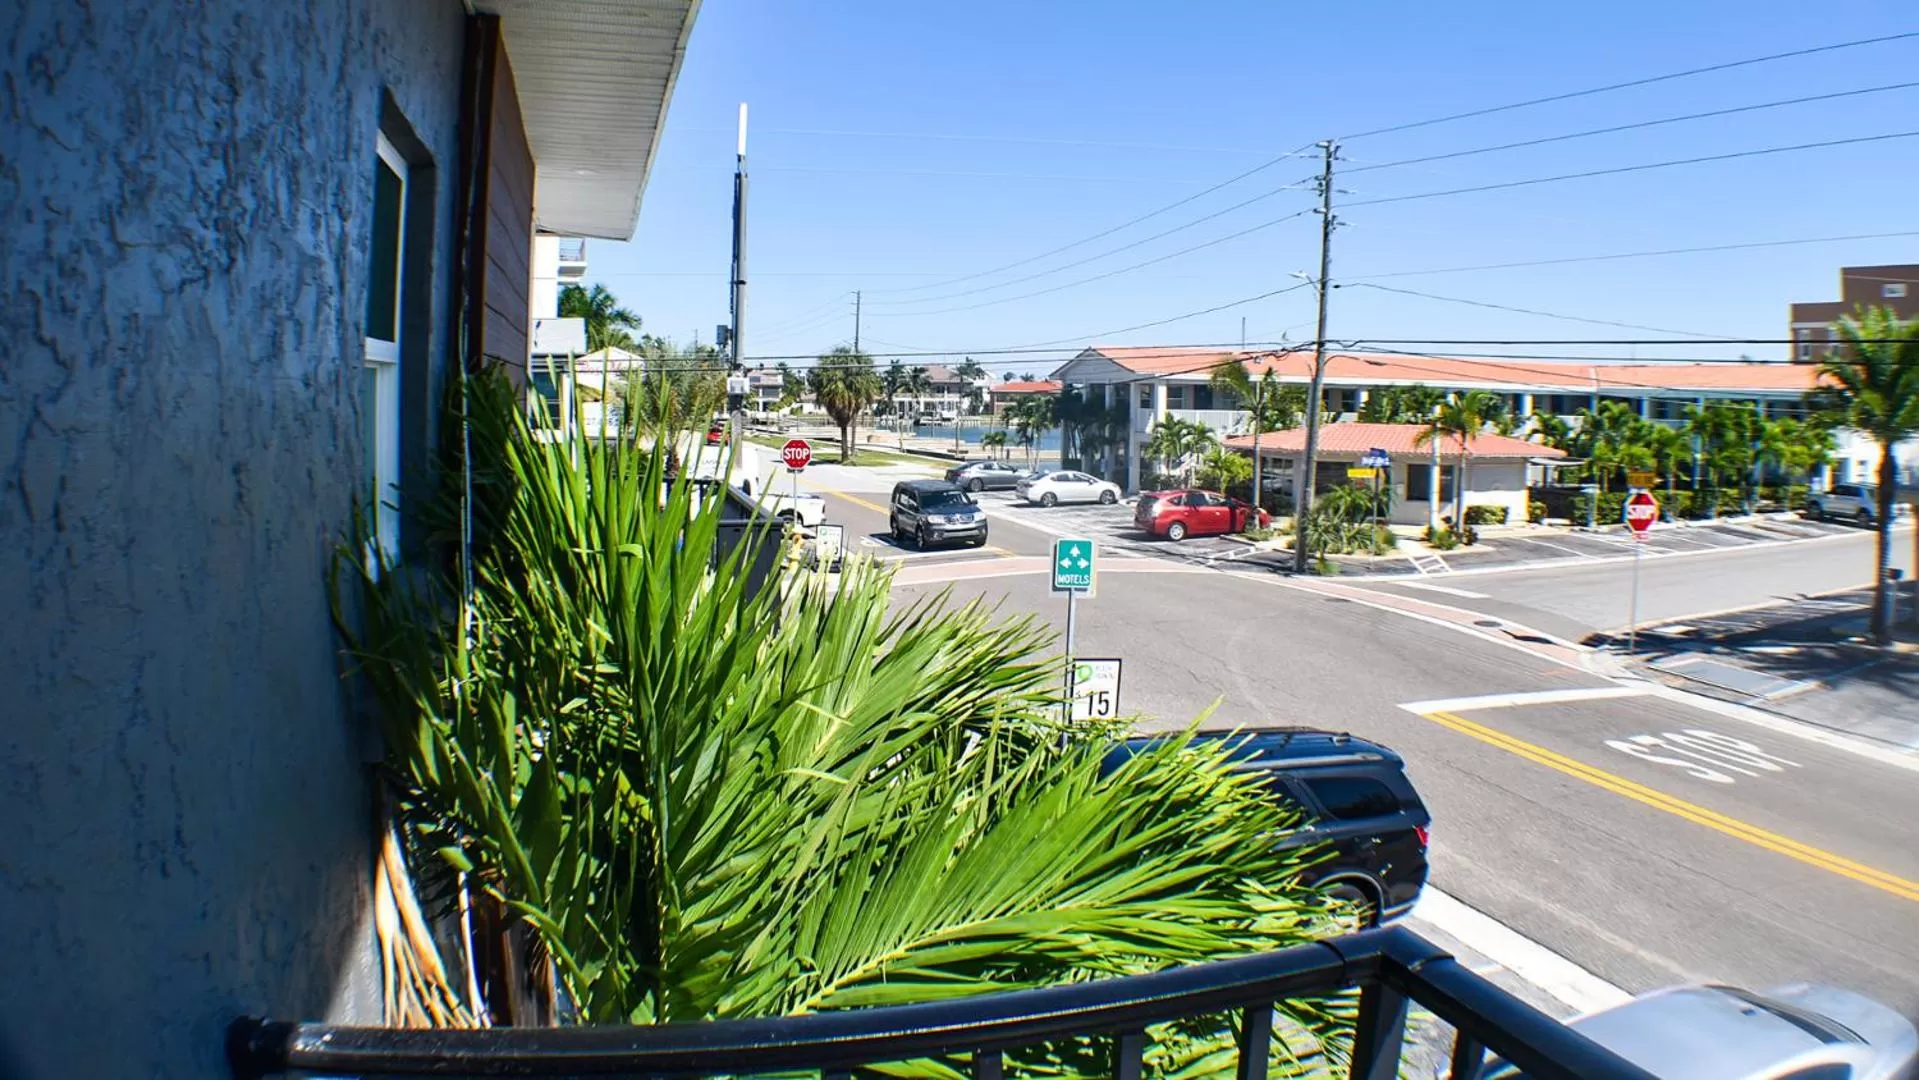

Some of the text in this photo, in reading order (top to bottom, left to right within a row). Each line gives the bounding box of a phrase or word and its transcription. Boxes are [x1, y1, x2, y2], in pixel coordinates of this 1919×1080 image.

[784, 447, 810, 460] STOP
[1628, 504, 1656, 519] STOP
[1058, 574, 1090, 584] MOTELS
[1088, 690, 1110, 716] 15
[1603, 729, 1803, 784] STOP
